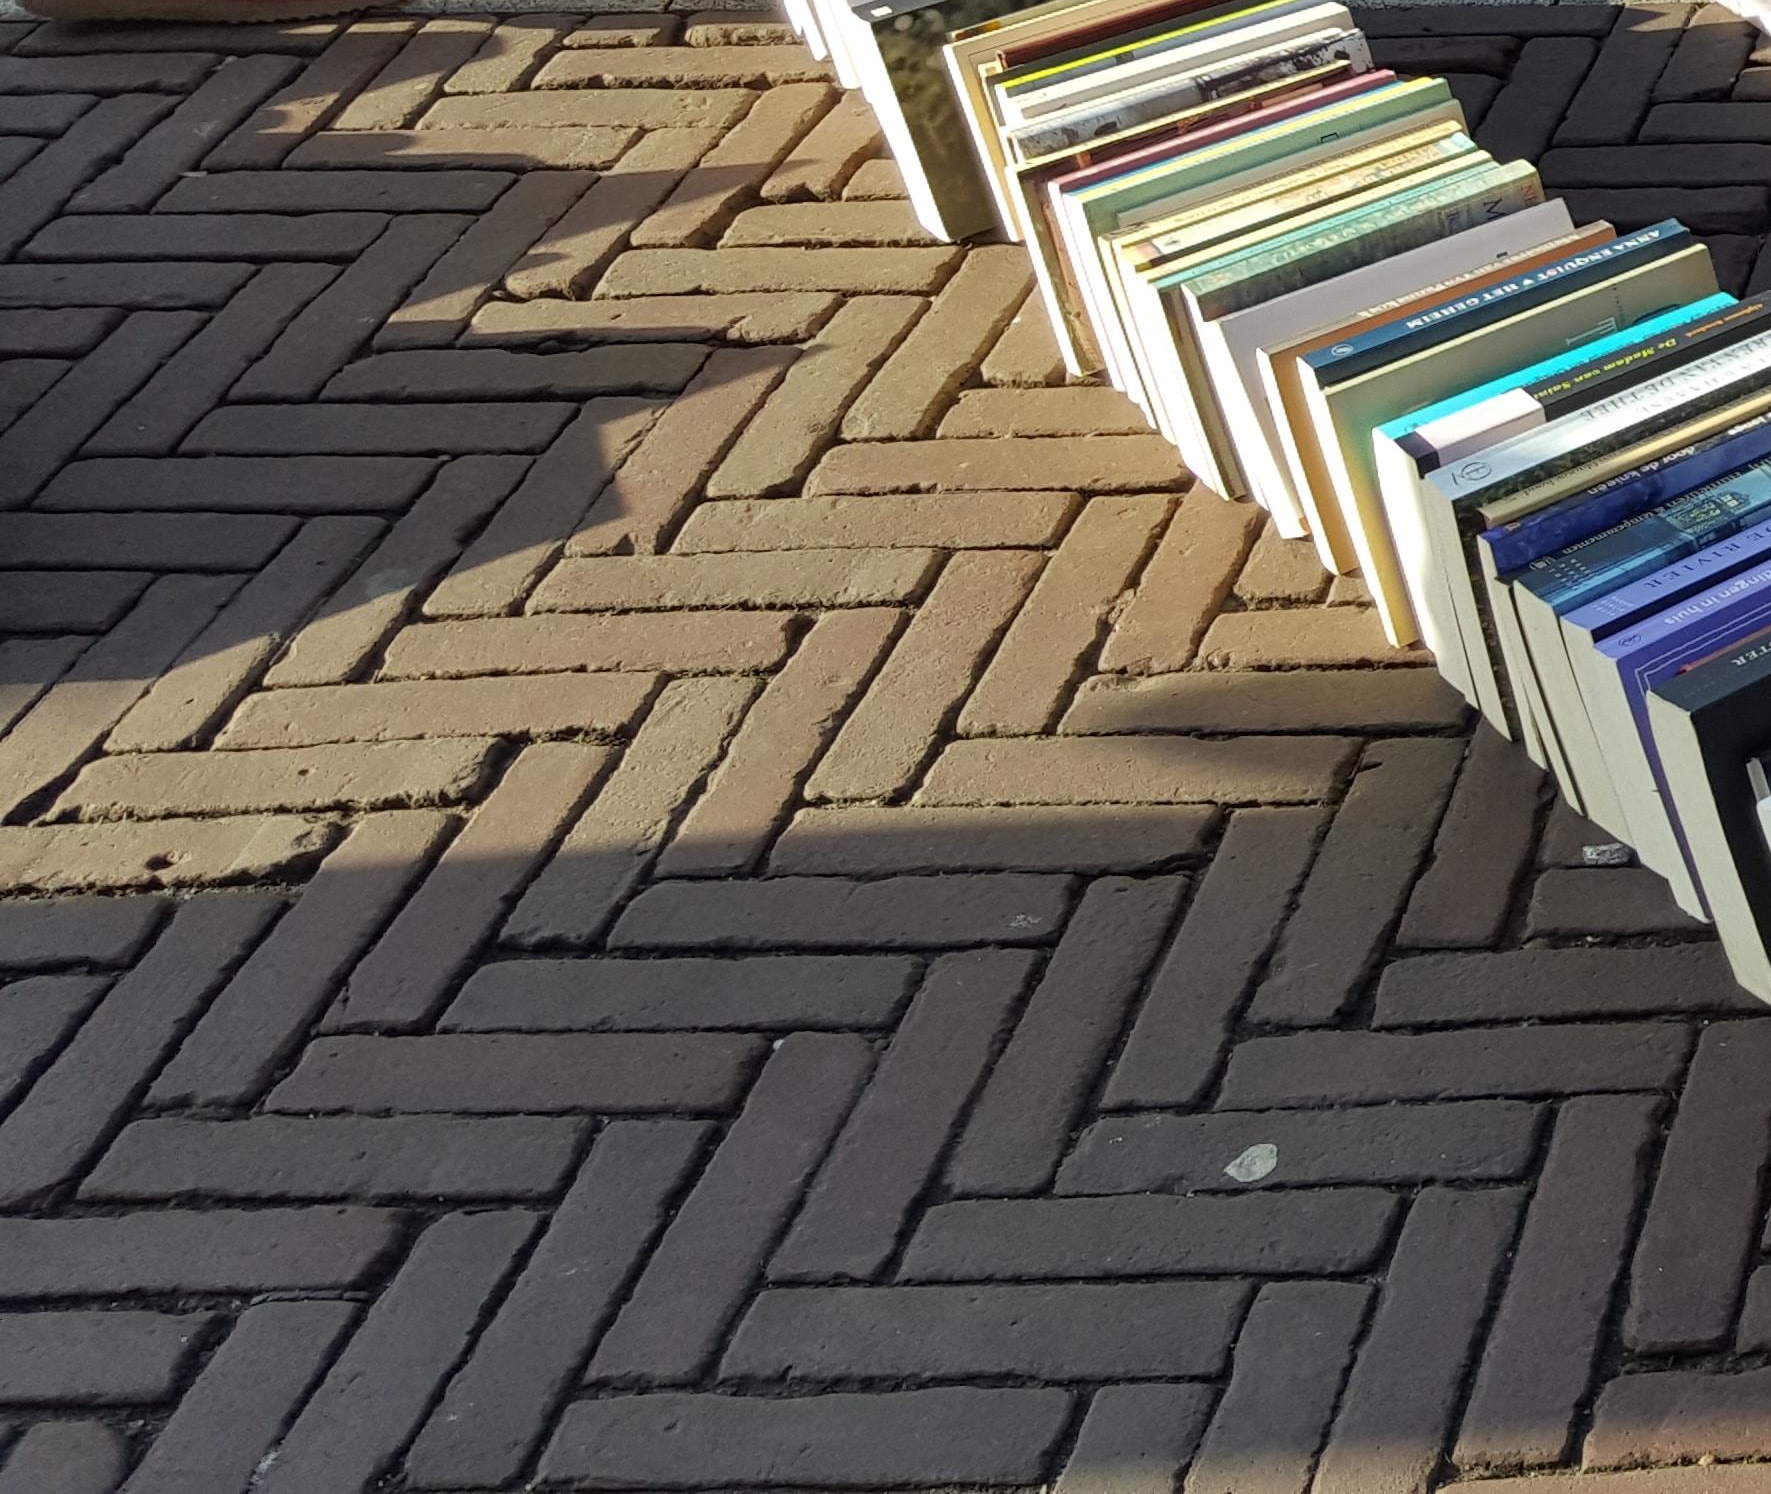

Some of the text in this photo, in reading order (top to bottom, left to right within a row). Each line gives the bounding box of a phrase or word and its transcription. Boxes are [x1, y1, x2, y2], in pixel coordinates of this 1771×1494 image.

[1405, 227, 1661, 330] ANNA ENQUIST HET GEHEIM
[1602, 335, 1677, 375] De Madam
[1644, 375, 1676, 396] DE
[1578, 389, 1640, 424] THEE
[1585, 443, 1697, 498] door de knieën
[1640, 538, 1741, 592] RIVIER
[1662, 603, 1701, 628] huis
[1699, 593, 1720, 610] in
